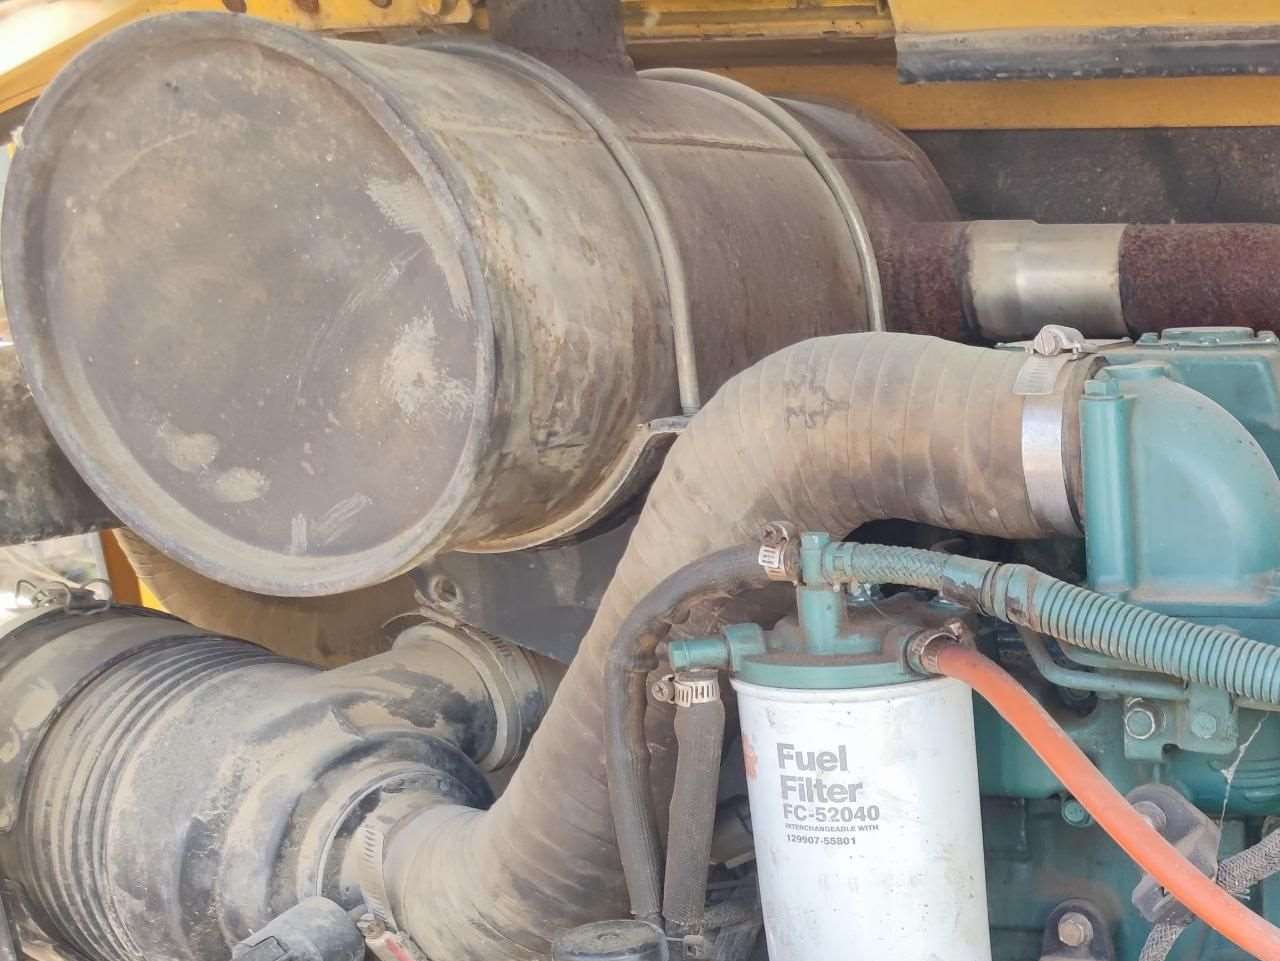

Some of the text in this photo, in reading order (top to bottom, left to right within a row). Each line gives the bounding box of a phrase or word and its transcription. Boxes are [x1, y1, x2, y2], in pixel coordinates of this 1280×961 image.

[776, 742, 848, 771] Fuel
[780, 774, 863, 803] Filter
[783, 803, 880, 822] FC-52040
[784, 822, 879, 833] INTERCHANGEABLE WITH
[787, 834, 856, 845] 129907-55801
